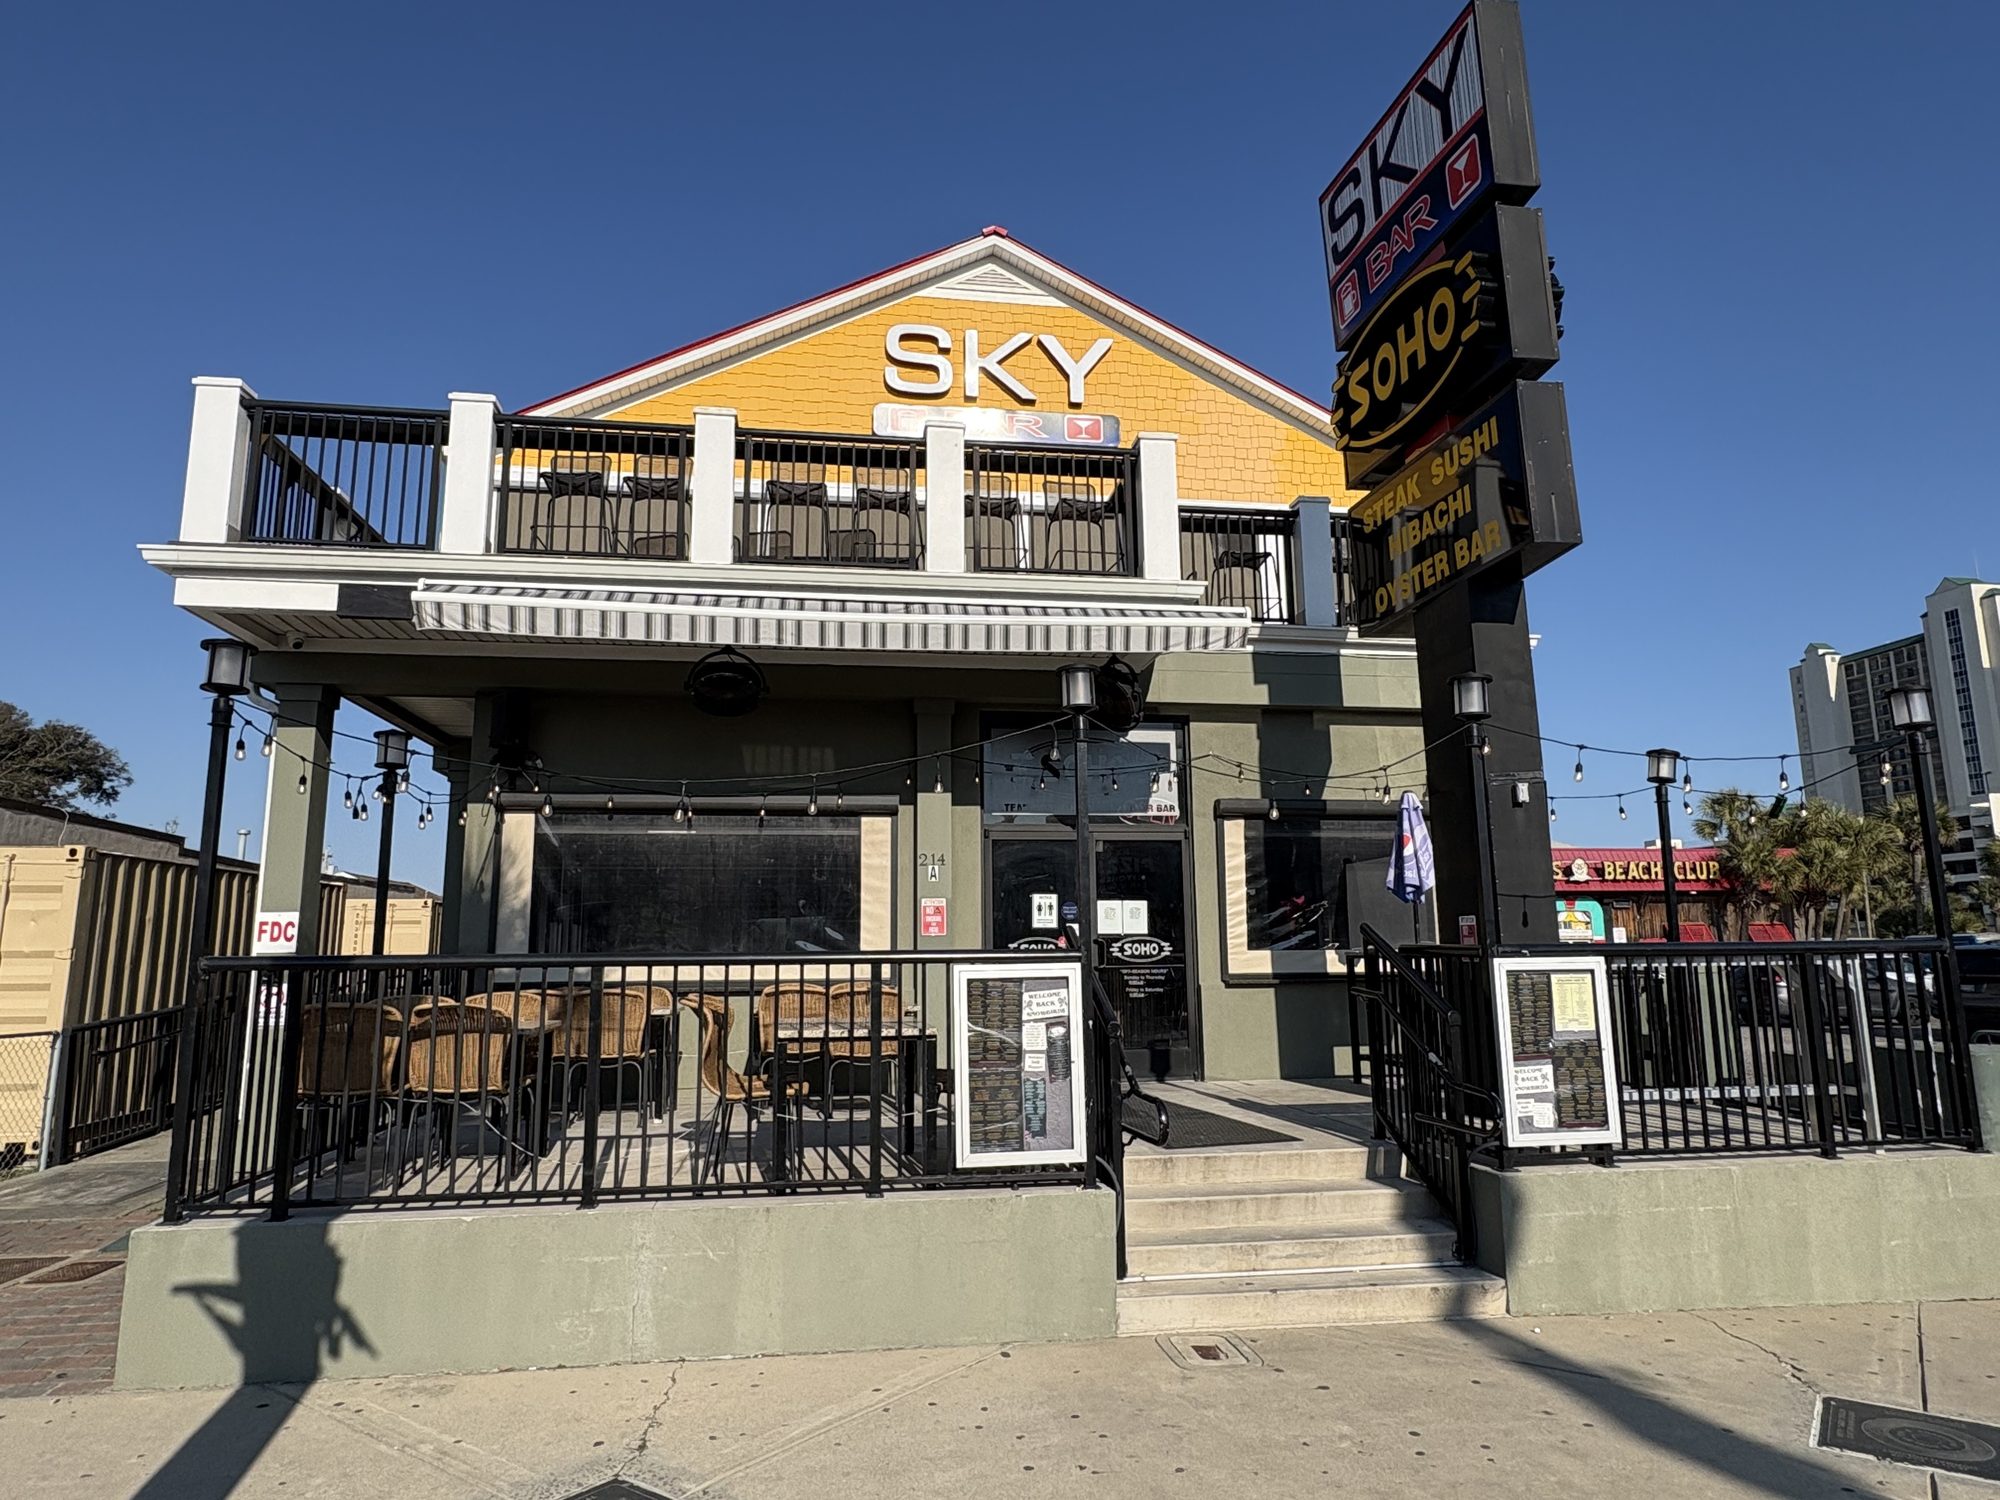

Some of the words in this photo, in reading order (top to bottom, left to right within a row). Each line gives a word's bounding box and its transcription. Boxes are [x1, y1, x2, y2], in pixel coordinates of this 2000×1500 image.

[1327, 22, 1470, 267] SKY
[1365, 194, 1439, 294] BAR
[884, 323, 1114, 406] SKY
[1348, 287, 1456, 428] SOHO
[1361, 472, 1422, 534] STEAK
[1430, 415, 1500, 486] SUSHI
[1388, 484, 1472, 561] HIBACHI
[1374, 553, 1450, 614] OYSTER
[1454, 519, 1501, 571] BAR
[1156, 804, 1176, 813] BAR
[918, 853, 947, 867] 214
[929, 866, 938, 881] A
[1603, 861, 1664, 880] BEACH
[1673, 861, 1721, 880] CLUB
[257, 921, 296, 942] FDC
[1123, 943, 1159, 956] SOHO
